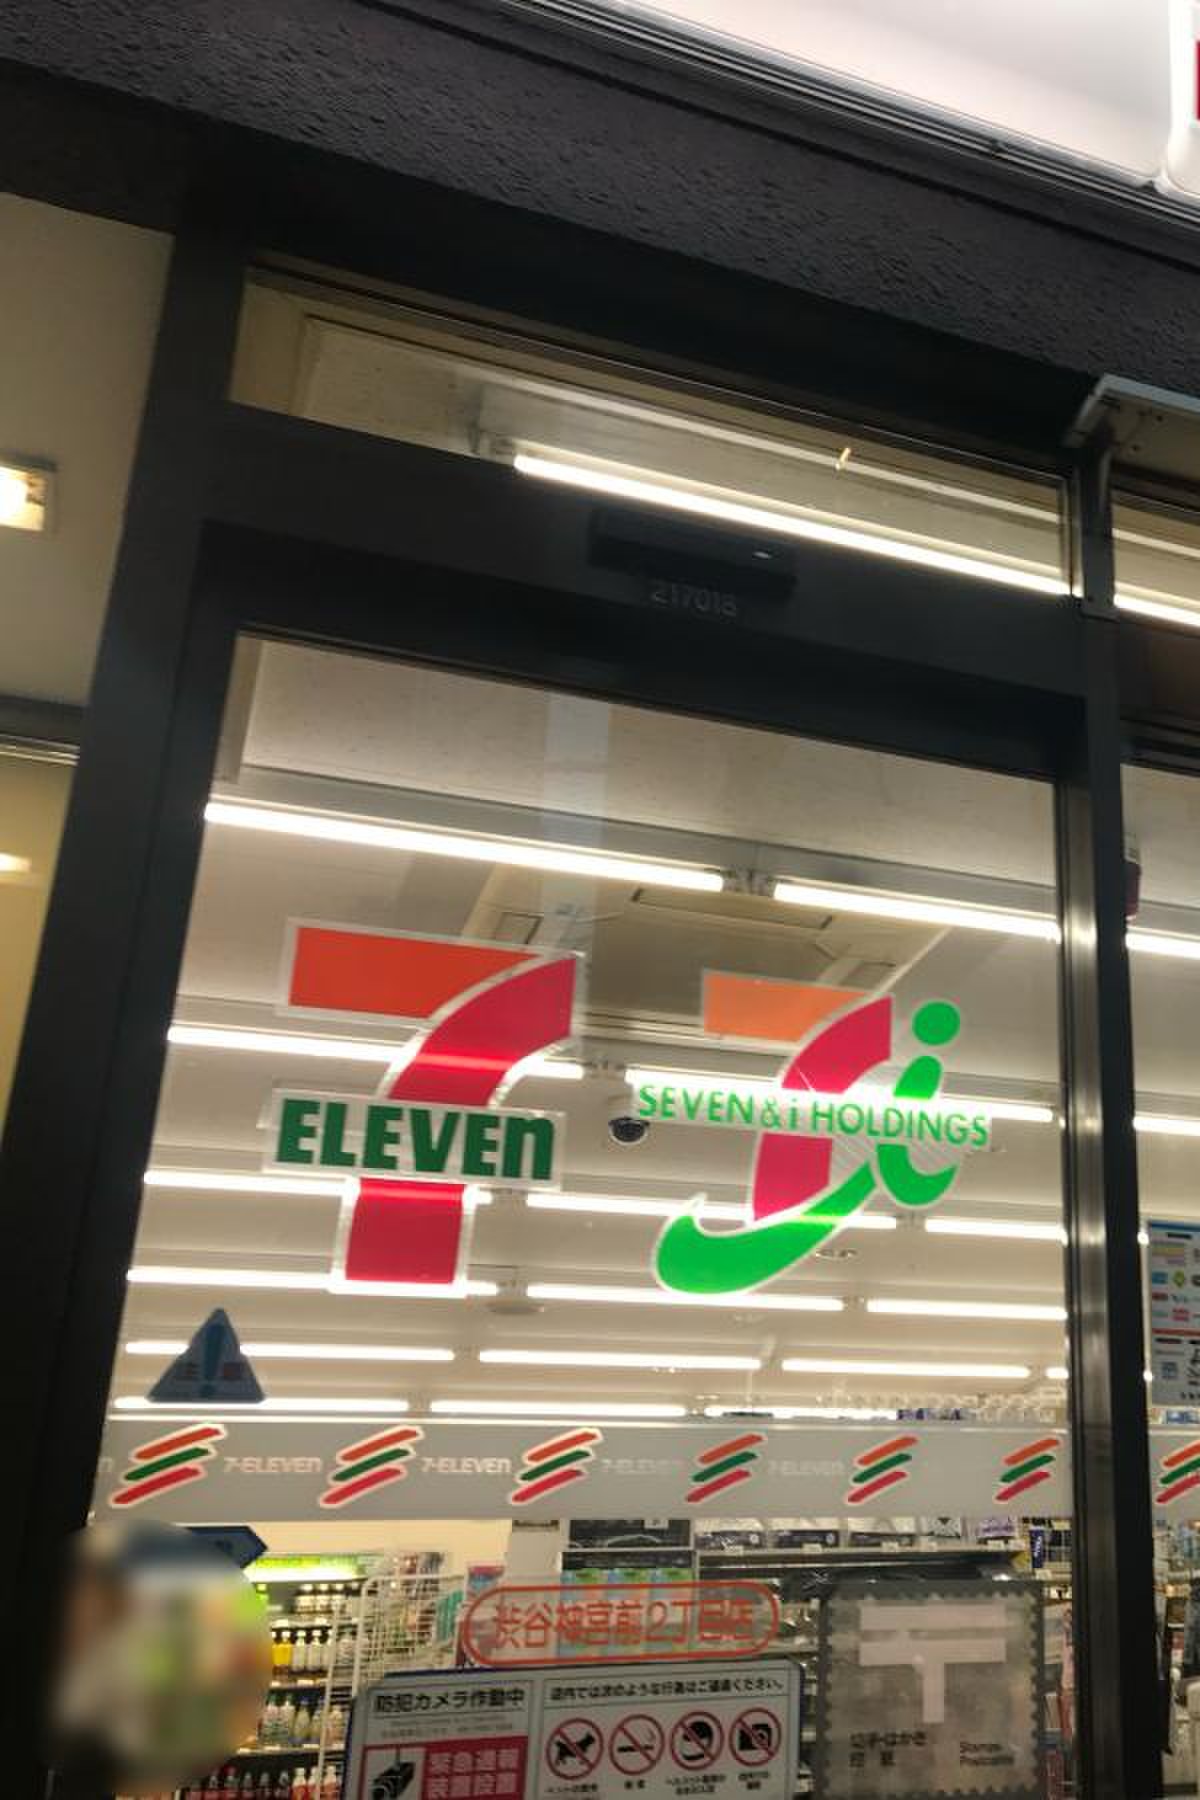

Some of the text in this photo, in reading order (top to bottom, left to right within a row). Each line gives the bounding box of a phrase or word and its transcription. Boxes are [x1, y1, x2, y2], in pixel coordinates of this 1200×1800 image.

[810, 1102, 989, 1147] HOLDINGS
[374, 1689, 525, 1713] 防犯カメラ作動中
